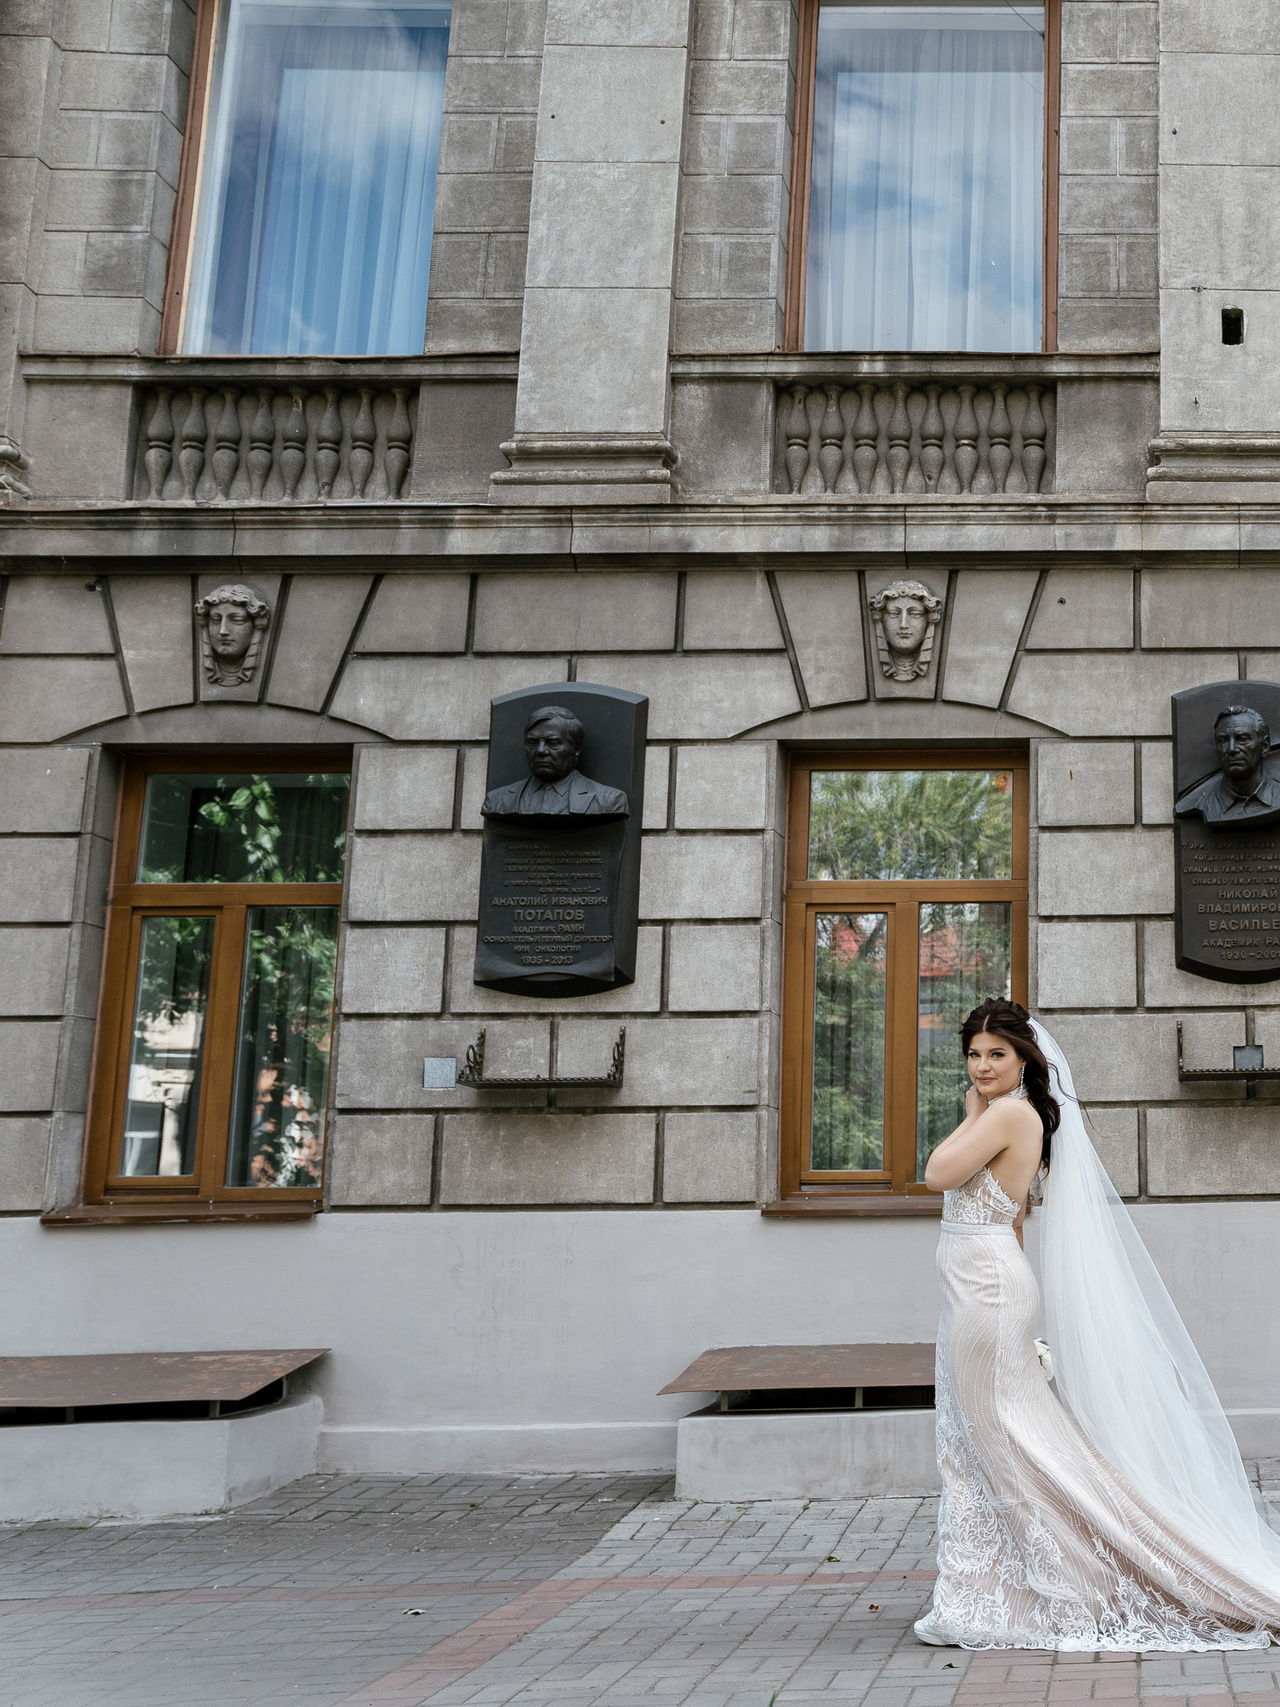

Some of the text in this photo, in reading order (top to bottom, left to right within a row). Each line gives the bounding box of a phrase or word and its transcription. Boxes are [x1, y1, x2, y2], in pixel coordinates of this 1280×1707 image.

[1183, 866, 1218, 874] СПАСИБО
[1192, 878, 1227, 886] СПАСИБО
[1218, 887, 1278, 899] НИКОЛАЙ
[492, 895, 608, 906] АНАТОЛИЙ ИВАНОВИЧ
[514, 909, 585, 921] ПОТАПОВ
[512, 923, 586, 934] АКАДЕМИК РАМН
[541, 934, 572, 943] ПЕРВЫЙ
[574, 935, 613, 943] ДИРЕКТОР
[1202, 938, 1259, 948] АКАДЕМИК
[514, 945, 582, 953] НИИ ОНКОЛОГИИ
[521, 955, 543, 965] 1935
[551, 955, 574, 964] 2013
